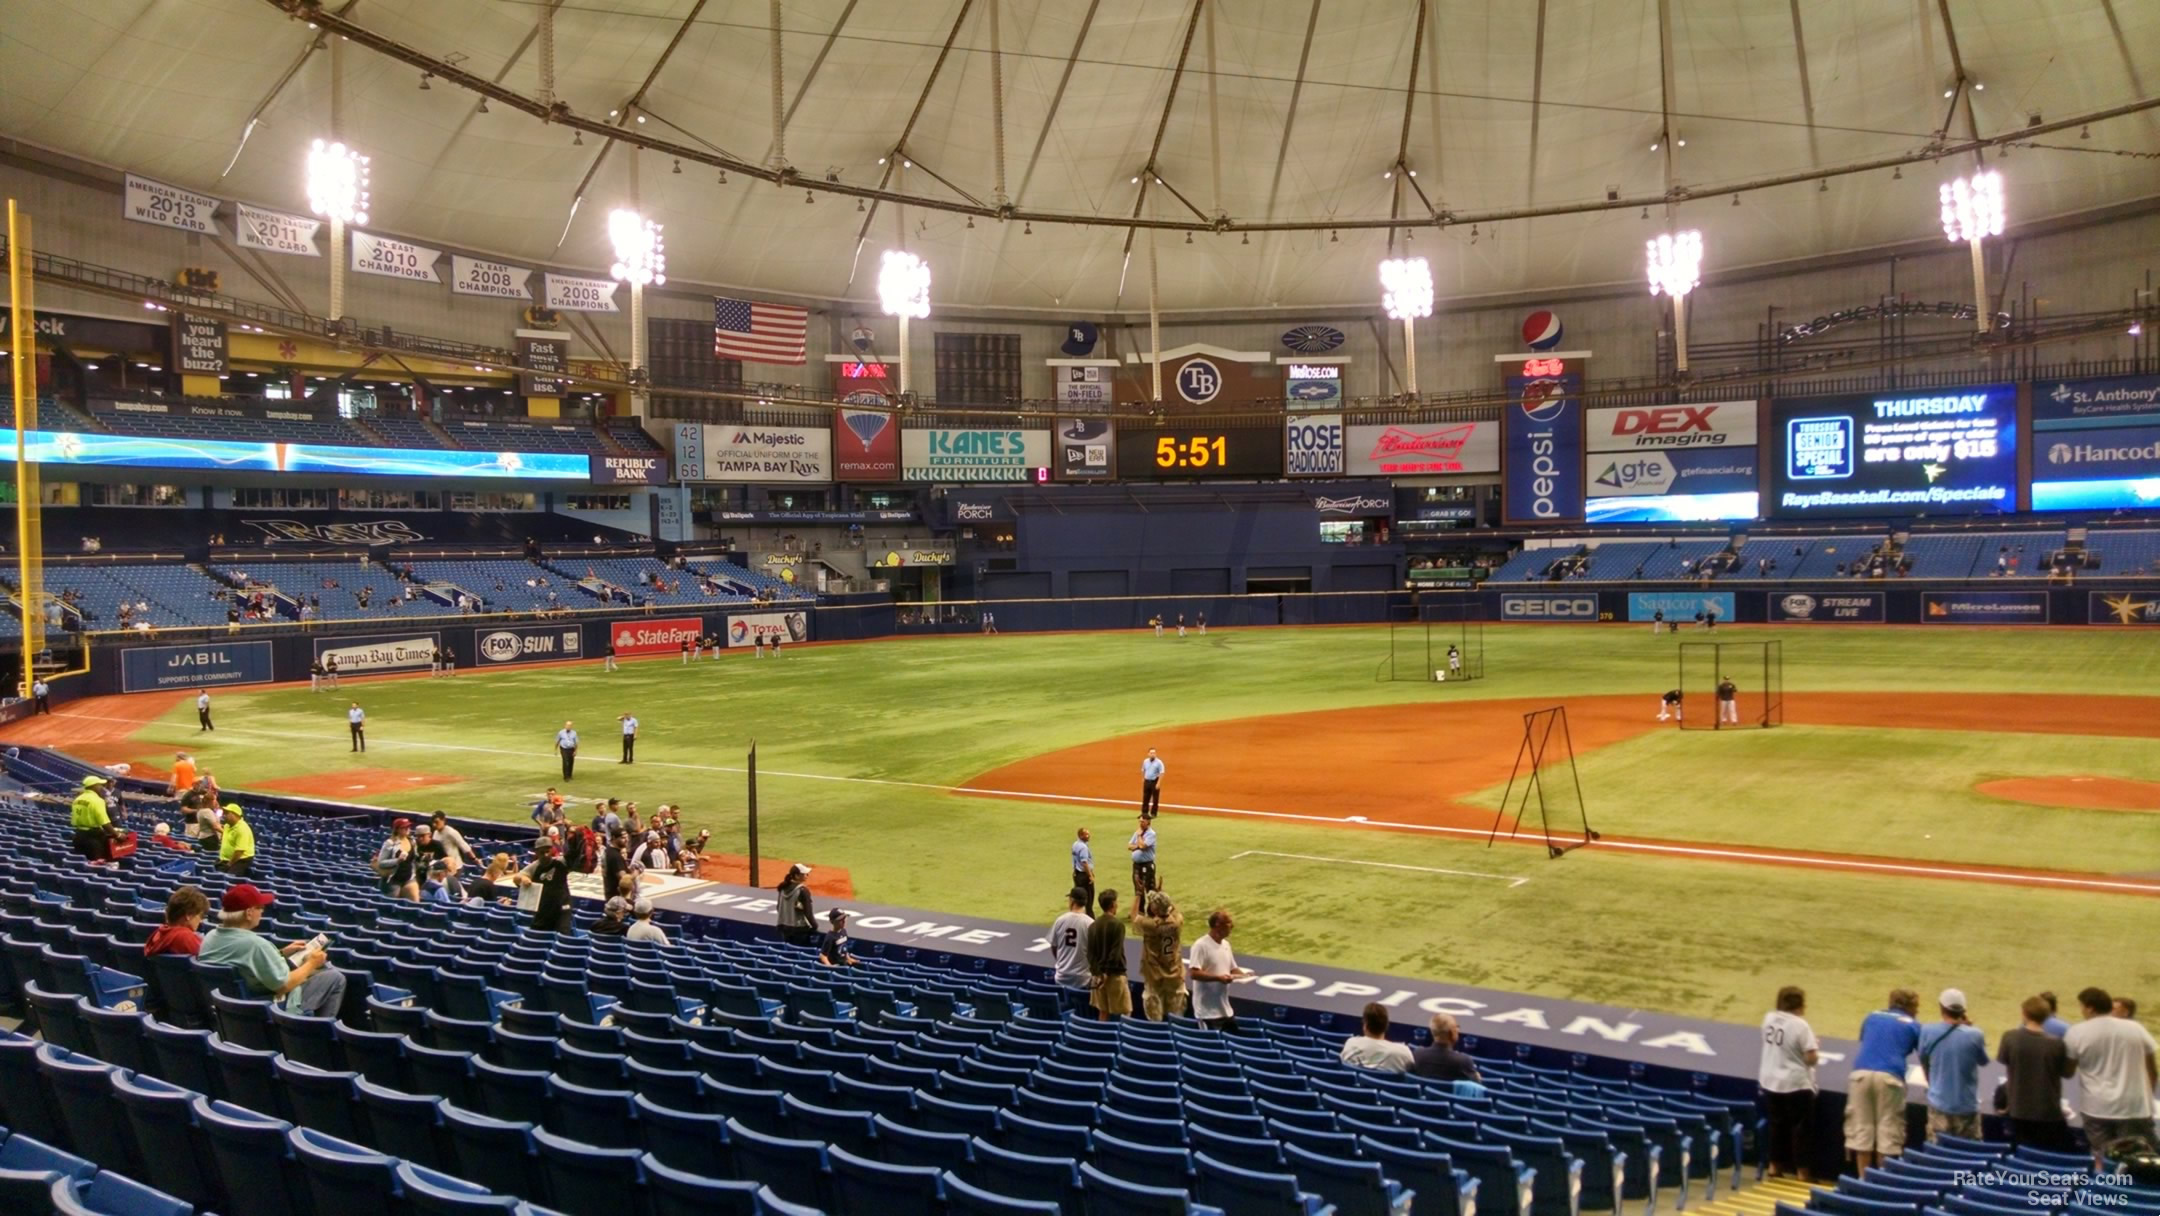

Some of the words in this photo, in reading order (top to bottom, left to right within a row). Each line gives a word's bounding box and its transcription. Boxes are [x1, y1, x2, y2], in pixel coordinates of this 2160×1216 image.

[129, 180, 176, 199] AMERICAN
[180, 193, 213, 208] LEAGUE
[150, 195, 196, 218] 2013
[136, 207, 167, 222] WILD
[173, 216, 206, 231] CARD
[259, 222, 298, 241] 2011
[279, 240, 308, 253] CARD
[376, 240, 389, 249] AL
[391, 242, 415, 253] EAST
[372, 248, 418, 267] 2010
[358, 259, 429, 279] CHAMPIONS
[474, 262, 484, 270] AL
[487, 263, 509, 272] EAST
[470, 270, 511, 286] 2008
[458, 281, 522, 297] CHAMPIONS
[562, 286, 599, 301] 2008
[551, 297, 609, 310] CHAMPIONS
[189, 325, 214, 336] you
[182, 333, 222, 348] heard
[530, 342, 554, 353] Fast
[191, 346, 215, 359] the
[183, 357, 223, 371] buzz?
[534, 383, 557, 392] use.
[1185, 367, 1214, 395] TB
[2073, 392, 2092, 403] St.
[191, 406, 215, 416] Know
[217, 408, 224, 416] it
[1874, 395, 1987, 417] THURSDAY
[2073, 404, 2104, 414] BayCare
[2106, 403, 2130, 411] Health
[1612, 405, 1719, 435] DEX
[680, 427, 698, 441] 42
[753, 432, 805, 447] Majestic
[1288, 426, 1341, 450] ROSE
[1636, 433, 1727, 446] imaging
[1801, 434, 1838, 448] SENIOR
[929, 431, 1025, 455] KANE'S
[683, 446, 696, 459] 12
[717, 450, 753, 459] OFFICIAL
[754, 451, 791, 459] UNIFORM
[803, 452, 819, 460] THE
[1157, 436, 1226, 467] 5:51
[1864, 447, 1901, 462] are
[1903, 442, 1951, 462] only
[1954, 439, 1998, 459] $15
[605, 458, 656, 469] REPUBLIC
[933, 457, 1020, 465] FURNITURE
[1289, 451, 1341, 472] RADIOLOGY
[1796, 450, 1844, 467] SPECIAL
[616, 468, 647, 479] BANK
[681, 464, 698, 478] 66
[717, 461, 761, 472] TAMPA
[764, 461, 787, 473] BAY
[840, 462, 895, 471] remax.com
[1622, 460, 1662, 482] gte
[1681, 466, 1752, 477] gtefinancial.org
[1528, 433, 1560, 517] pepsi
[1358, 499, 1389, 508] PORCH
[1782, 486, 2005, 508] RaysBaseball.com/Specials
[958, 510, 992, 519] PORCH
[241, 520, 425, 546] RAYS
[767, 554, 803, 566] Ducky's
[913, 551, 951, 564] Ducky's
[1505, 600, 1594, 616] GEICO
[1638, 596, 1696, 612] Sagicor
[1822, 598, 1872, 607] STREAM
[1600, 612, 1613, 620] 370
[1834, 607, 1859, 617] LIVE
[752, 624, 785, 634] TOTAL
[490, 638, 513, 649] FOX
[523, 636, 554, 653] SUN
[168, 651, 231, 667] JABIL
[327, 653, 367, 669] Tampa
[369, 649, 393, 664] Bay
[396, 646, 431, 661] Times
[158, 675, 190, 684] SUPPORTS
[191, 674, 204, 682] OUR
[204, 672, 242, 682] COMMUNITY
[690, 891, 1008, 945] WECOME
[1065, 927, 1077, 947] 2
[1766, 1026, 1784, 1046] 20
